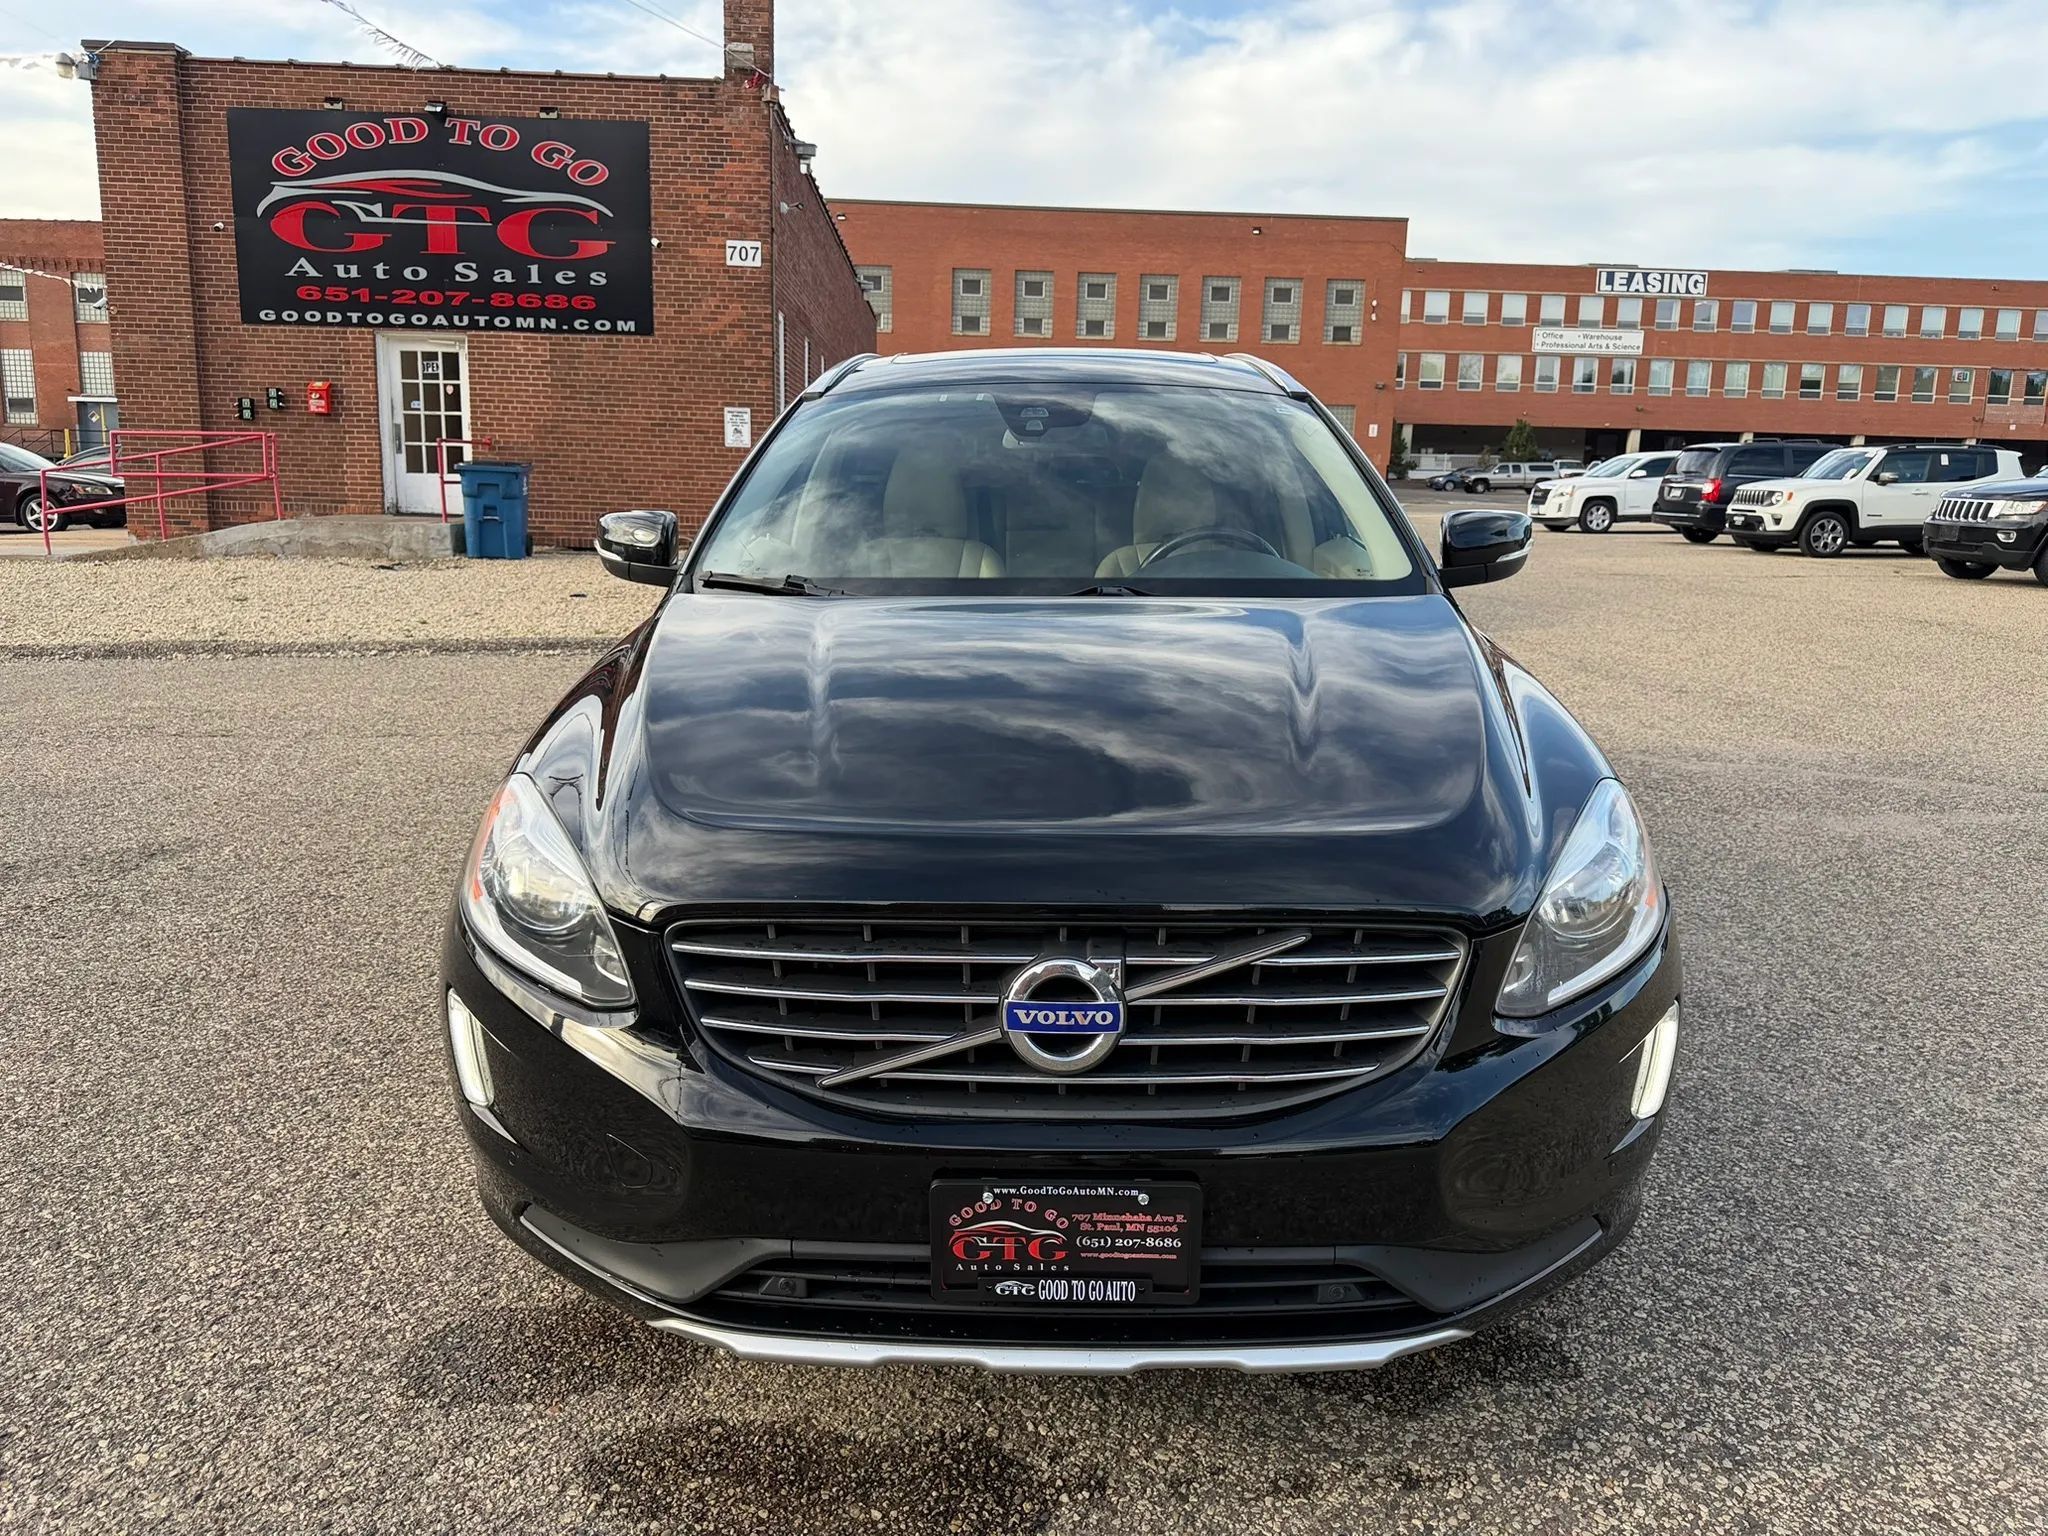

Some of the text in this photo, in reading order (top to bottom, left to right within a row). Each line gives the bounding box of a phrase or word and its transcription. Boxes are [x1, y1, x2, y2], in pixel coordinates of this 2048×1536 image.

[271, 117, 610, 186] GOOD TO GO
[270, 201, 616, 260] GTG
[727, 246, 760, 262] 707
[284, 257, 608, 286] Auto Sales
[1600, 271, 1705, 294] LEASING
[296, 285, 597, 310] 651-207-8686
[258, 309, 636, 332] GOODTOGOAUTOMN.COM
[1541, 332, 1623, 341] Office Warehouse
[1541, 341, 1586, 349] Professional
[1013, 1009, 1114, 1025] VOLVO
[993, 1186, 1139, 1197] www.GoodToGoAutoMN.com
[949, 1198, 1069, 1229] GOOD TO GO
[1154, 1214, 1174, 1222] Ave
[1126, 1223, 1145, 1231] MN
[952, 1237, 1069, 1260] GTG
[1076, 1235, 1182, 1248] (651) 207-8686
[955, 1262, 1069, 1271] Auto Sales
[1038, 1279, 1068, 1300] GOOD
[1071, 1280, 1086, 1300] TO
[1088, 1280, 1104, 1301] GO
[1105, 1280, 1136, 1301] AUTO
